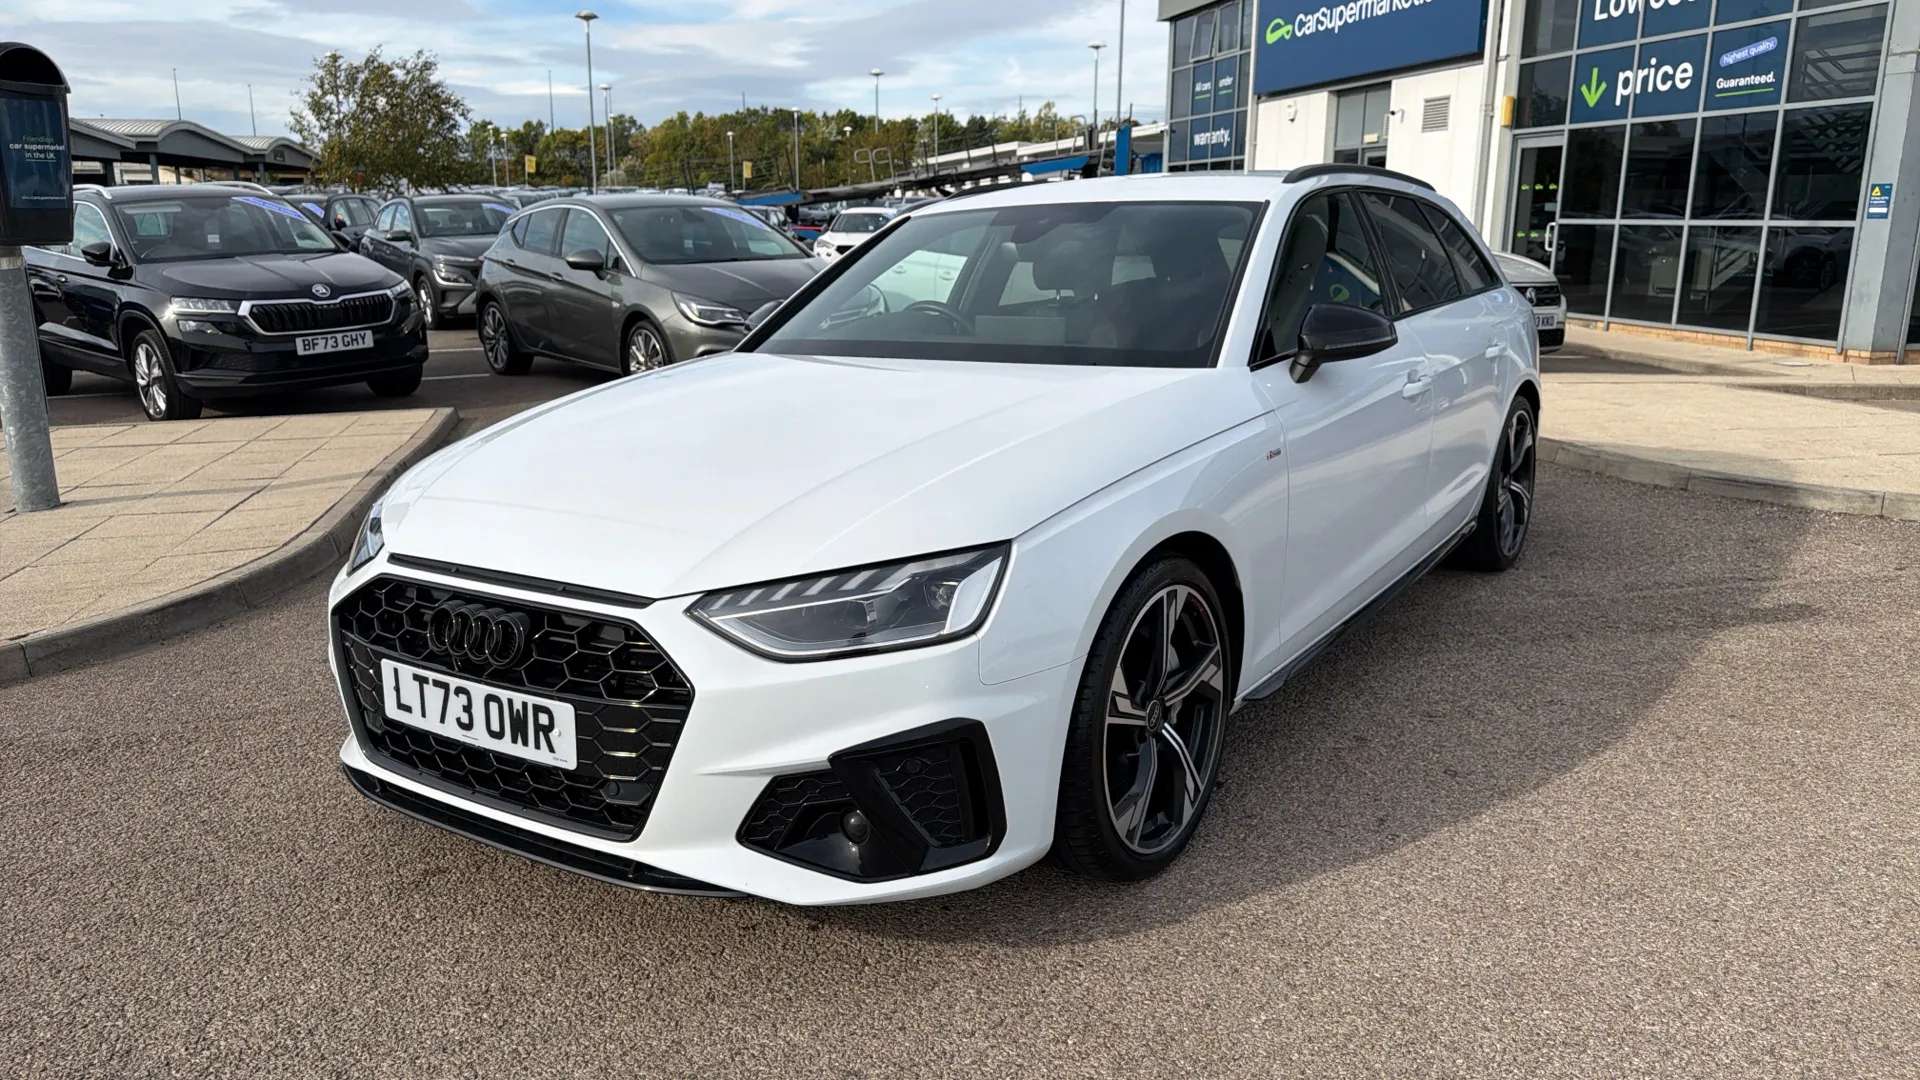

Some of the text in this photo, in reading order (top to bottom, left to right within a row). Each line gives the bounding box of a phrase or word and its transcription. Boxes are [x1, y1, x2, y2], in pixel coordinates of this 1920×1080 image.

[1723, 48, 1748, 65] highest
[1615, 57, 1693, 106] price
[1716, 71, 1776, 89] Guaranteed.
[1193, 128, 1230, 147] warranty.
[24, 143, 65, 151] supermarket
[25, 151, 32, 159] in
[33, 151, 45, 159] the
[302, 332, 366, 352] BF73 GHY
[394, 667, 556, 754] LT73 OWR
